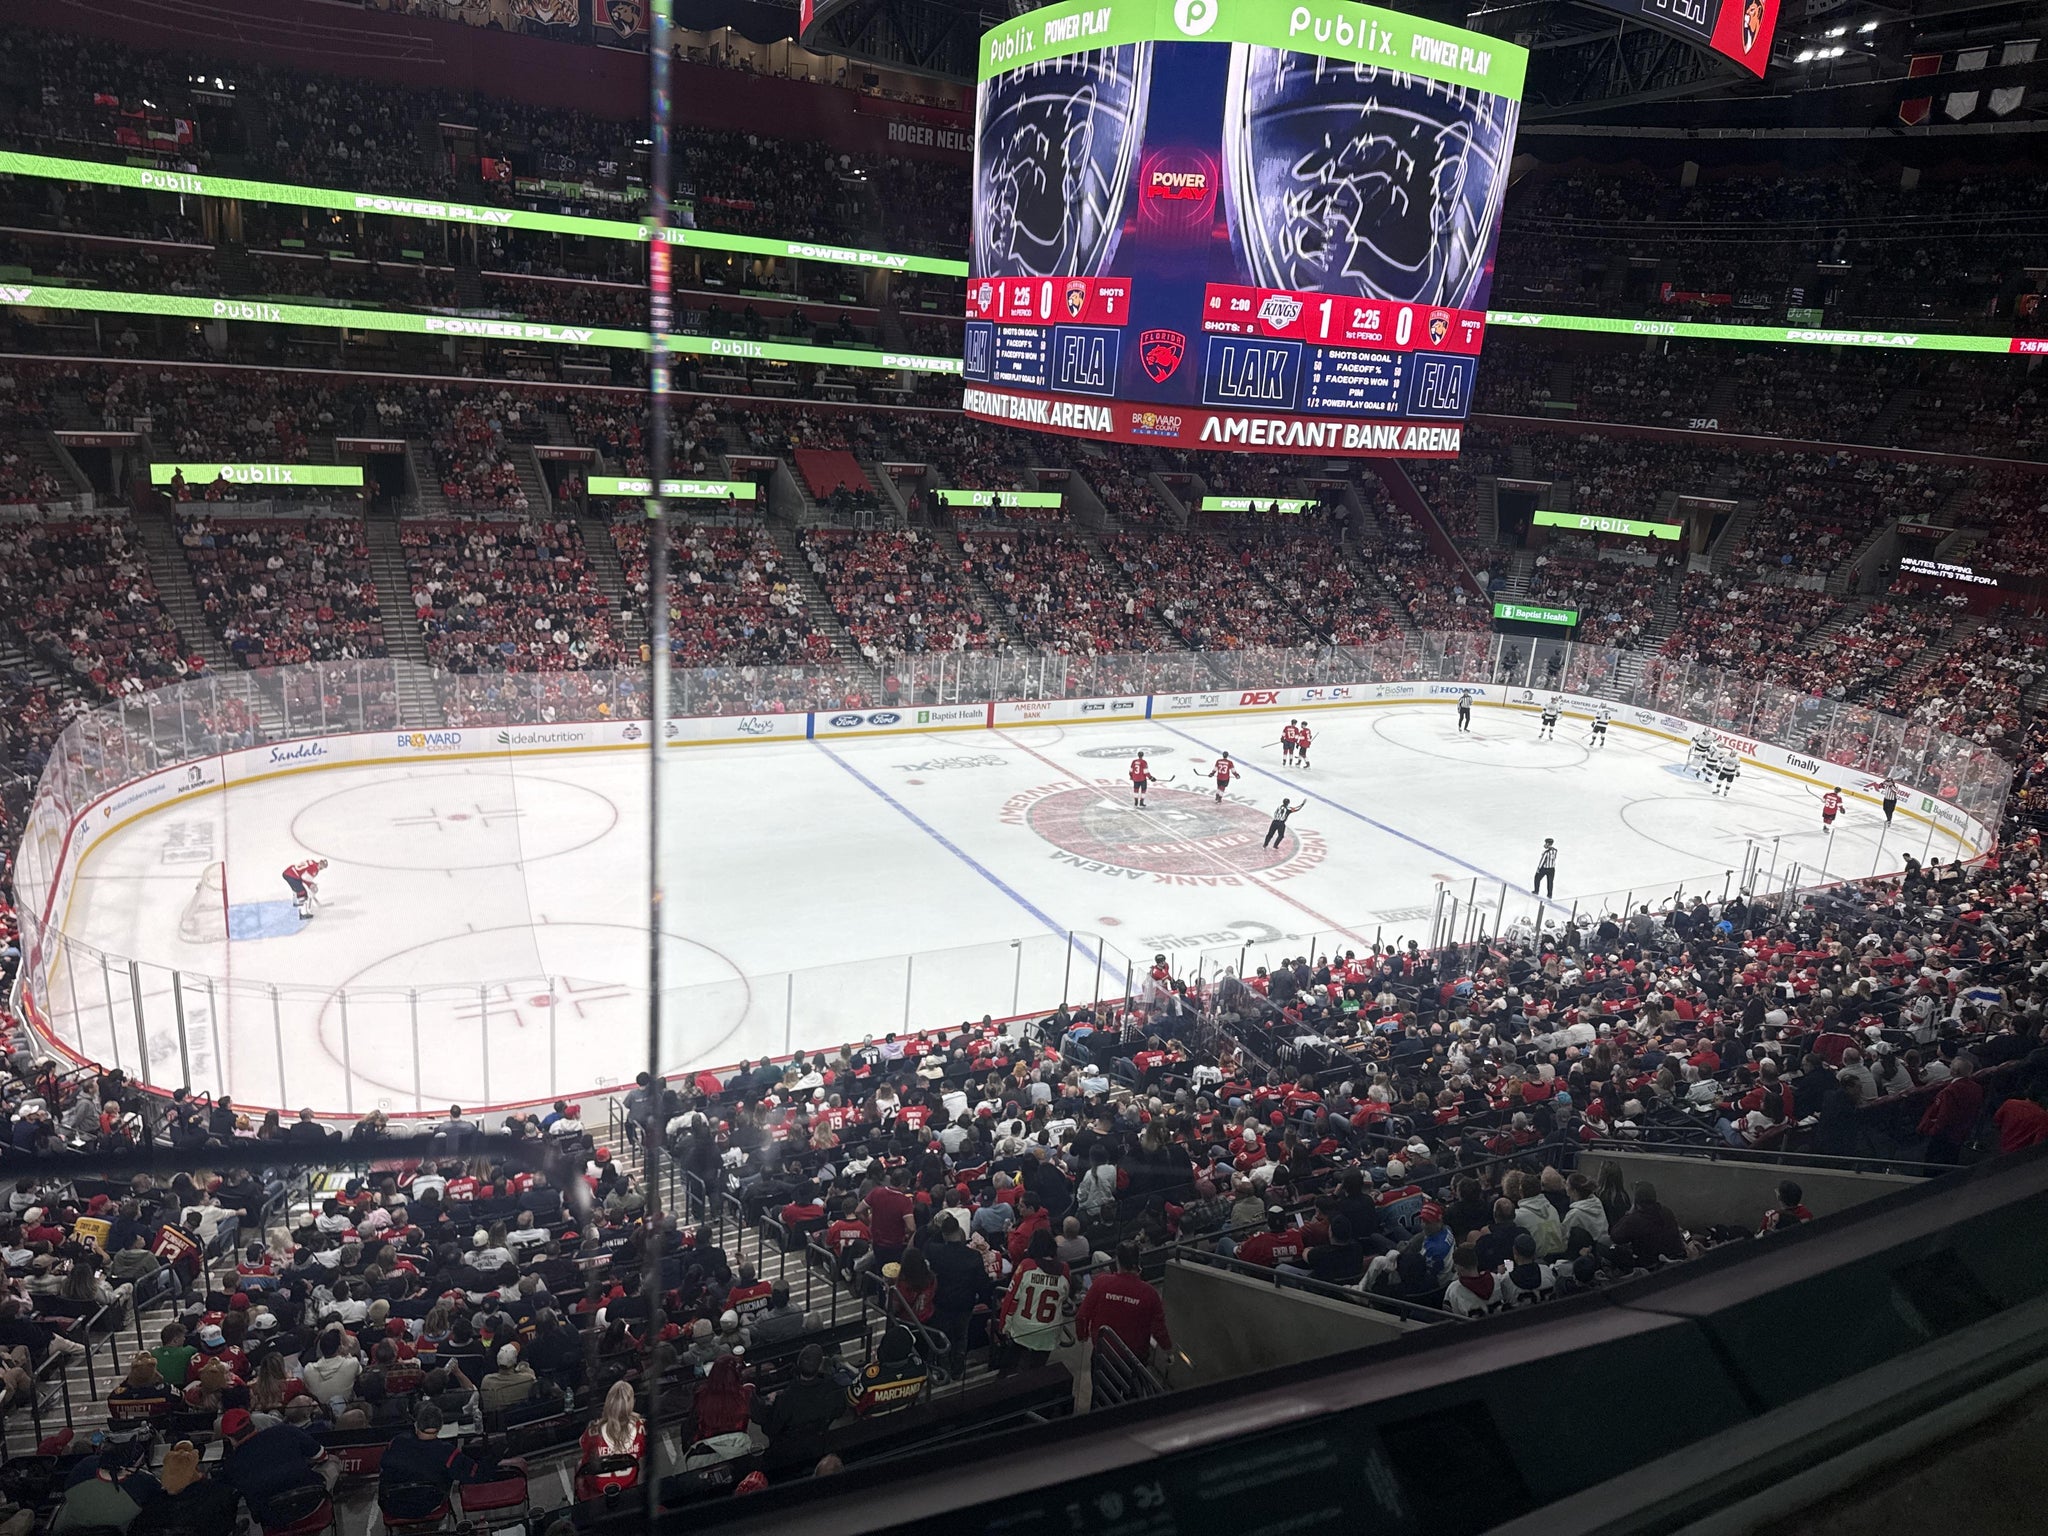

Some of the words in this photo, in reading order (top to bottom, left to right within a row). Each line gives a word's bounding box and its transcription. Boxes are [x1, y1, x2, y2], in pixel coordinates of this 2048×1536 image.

[1044, 14, 1080, 45] POWER
[1081, 7, 1112, 35] PLAY
[1411, 33, 1459, 68] POWER
[1459, 45, 1492, 76] PLAY
[888, 122, 934, 145] ROGER
[141, 171, 204, 193] Publix
[1152, 172, 1206, 188] POWER
[1147, 186, 1210, 201] PLAY
[354, 196, 449, 218] POWER
[449, 206, 513, 223] PLAY
[787, 244, 858, 264] POWER
[858, 253, 909, 267] PLAY
[998, 281, 1006, 318] 1
[1014, 286, 1031, 306] 2:25
[1040, 280, 1053, 320] 0
[1099, 288, 1124, 297] SHOTS
[213, 301, 281, 321] Publix
[1106, 297, 1114, 314] 5
[1209, 296, 1221, 309] 40
[1230, 298, 1251, 312] 2:00
[1263, 302, 1299, 319] KINGS
[1319, 298, 1333, 339] 1
[1352, 308, 1380, 330] 2:25
[1395, 306, 1413, 346] 0
[1461, 320, 1481, 329] SHOTS
[1494, 313, 1546, 326] PLAY
[425, 317, 523, 338] POWER
[524, 326, 594, 342] PLAY
[1204, 321, 1241, 332] SHOTS:
[1246, 324, 1254, 333] 8
[1633, 321, 1676, 335] Publix
[1144, 332, 1181, 344] FLORIDA
[1356, 333, 1382, 342] PERIOD
[1466, 329, 1472, 344] 5
[1786, 330, 1862, 345] POWER
[1862, 334, 1920, 346] PLAY
[711, 340, 763, 358] Publix
[966, 330, 988, 373] LAK
[2019, 341, 2037, 352] 7:45
[882, 355, 956, 370] POWER
[1061, 336, 1104, 386] FLA
[1328, 350, 1357, 361] SHOTS
[1357, 353, 1371, 362] ON
[1370, 354, 1392, 363] GOAL
[1218, 346, 1289, 400] LAK
[1336, 363, 1376, 374] FACEOFF
[1375, 366, 1382, 374] %
[1325, 375, 1370, 385] FACEOFFS
[1370, 378, 1389, 387] WON
[1418, 362, 1463, 410] FLA
[1348, 388, 1364, 397] PIM
[962, 387, 1010, 417] AMERANT
[1010, 395, 1051, 425] BANK
[1050, 400, 1114, 433] ARENA
[1307, 397, 1320, 408] 1/2
[1322, 398, 1346, 408] POWER
[1346, 399, 1363, 409] PLAY
[1363, 401, 1385, 411] GOALS
[1132, 412, 1182, 427] BROWARD
[1199, 416, 1343, 448] AMERANT
[1342, 423, 1403, 450] BANK
[1402, 427, 1461, 452] ARENA
[579, 450, 592, 461] 117
[221, 465, 293, 484] Publix
[681, 483, 729, 495] PLAY
[1579, 515, 1631, 533] Publix
[1901, 557, 1936, 569] MINUTES,
[1909, 566, 1940, 577] Andrew:
[1939, 571, 1955, 579] IT'S
[1954, 573, 1974, 582] TIME
[1973, 576, 1991, 585] FOR
[1990, 578, 1998, 586] A
[1515, 608, 1542, 620] Baptist
[1542, 612, 1568, 622] Health
[1306, 688, 1323, 698] CH
[1332, 687, 1349, 697] CH
[1384, 685, 1414, 694] BioStem
[1239, 691, 1280, 706] DEX
[931, 709, 958, 723] Baptist
[958, 707, 984, 719] Health
[1014, 702, 1052, 712] AMERANT
[1023, 710, 1041, 720] BANK
[834, 714, 860, 727] Ford
[872, 712, 898, 725] Ford
[397, 732, 462, 748] BROWARD
[269, 742, 328, 764] Sandals
[1134, 764, 1140, 774] 3
[1217, 764, 1229, 774] 23
[1785, 753, 1820, 775] finally
[999, 780, 1075, 826] AMERANT
[1933, 804, 1954, 822] Baptist
[1127, 831, 1251, 855] PANTHERS
[1263, 827, 1329, 883] AMERANT
[1048, 849, 1149, 881] ARENA
[1152, 873, 1244, 887] BANK
[1146, 930, 1242, 951] CELSIUS
[1348, 963, 1364, 977] 70
[829, 1116, 843, 1130] 19
[79, 1222, 100, 1233] TAYLOR
[1030, 1272, 1059, 1288] HORTON
[1020, 1285, 1060, 1324] 16
[1105, 1292, 1123, 1303] EVENT
[1123, 1296, 1140, 1306] STAFF
[874, 1382, 921, 1402] MARCHAND
